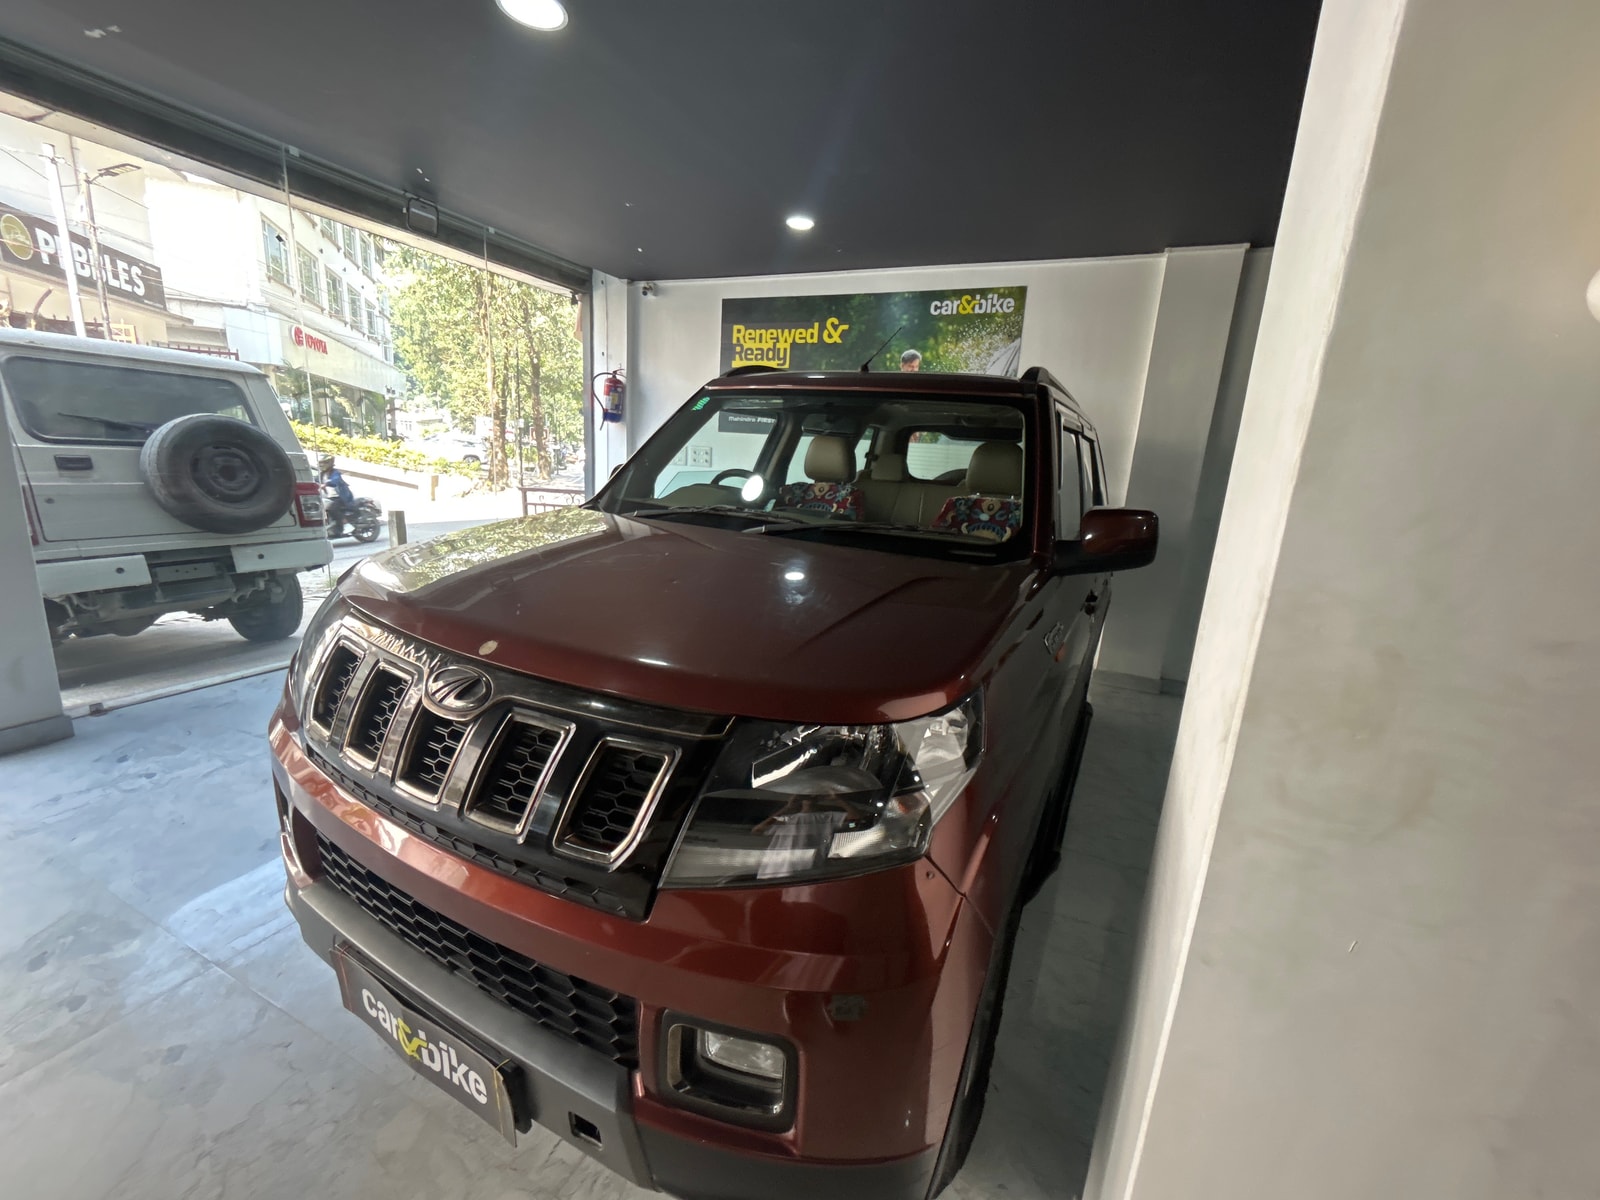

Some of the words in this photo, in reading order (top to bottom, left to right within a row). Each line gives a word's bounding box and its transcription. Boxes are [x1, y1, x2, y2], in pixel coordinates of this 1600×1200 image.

[930, 293, 1015, 316] car&bike
[731, 322, 819, 345] Renewed
[822, 317, 849, 344] &
[734, 344, 789, 367] Ready
[361, 988, 488, 1105] car&bike
